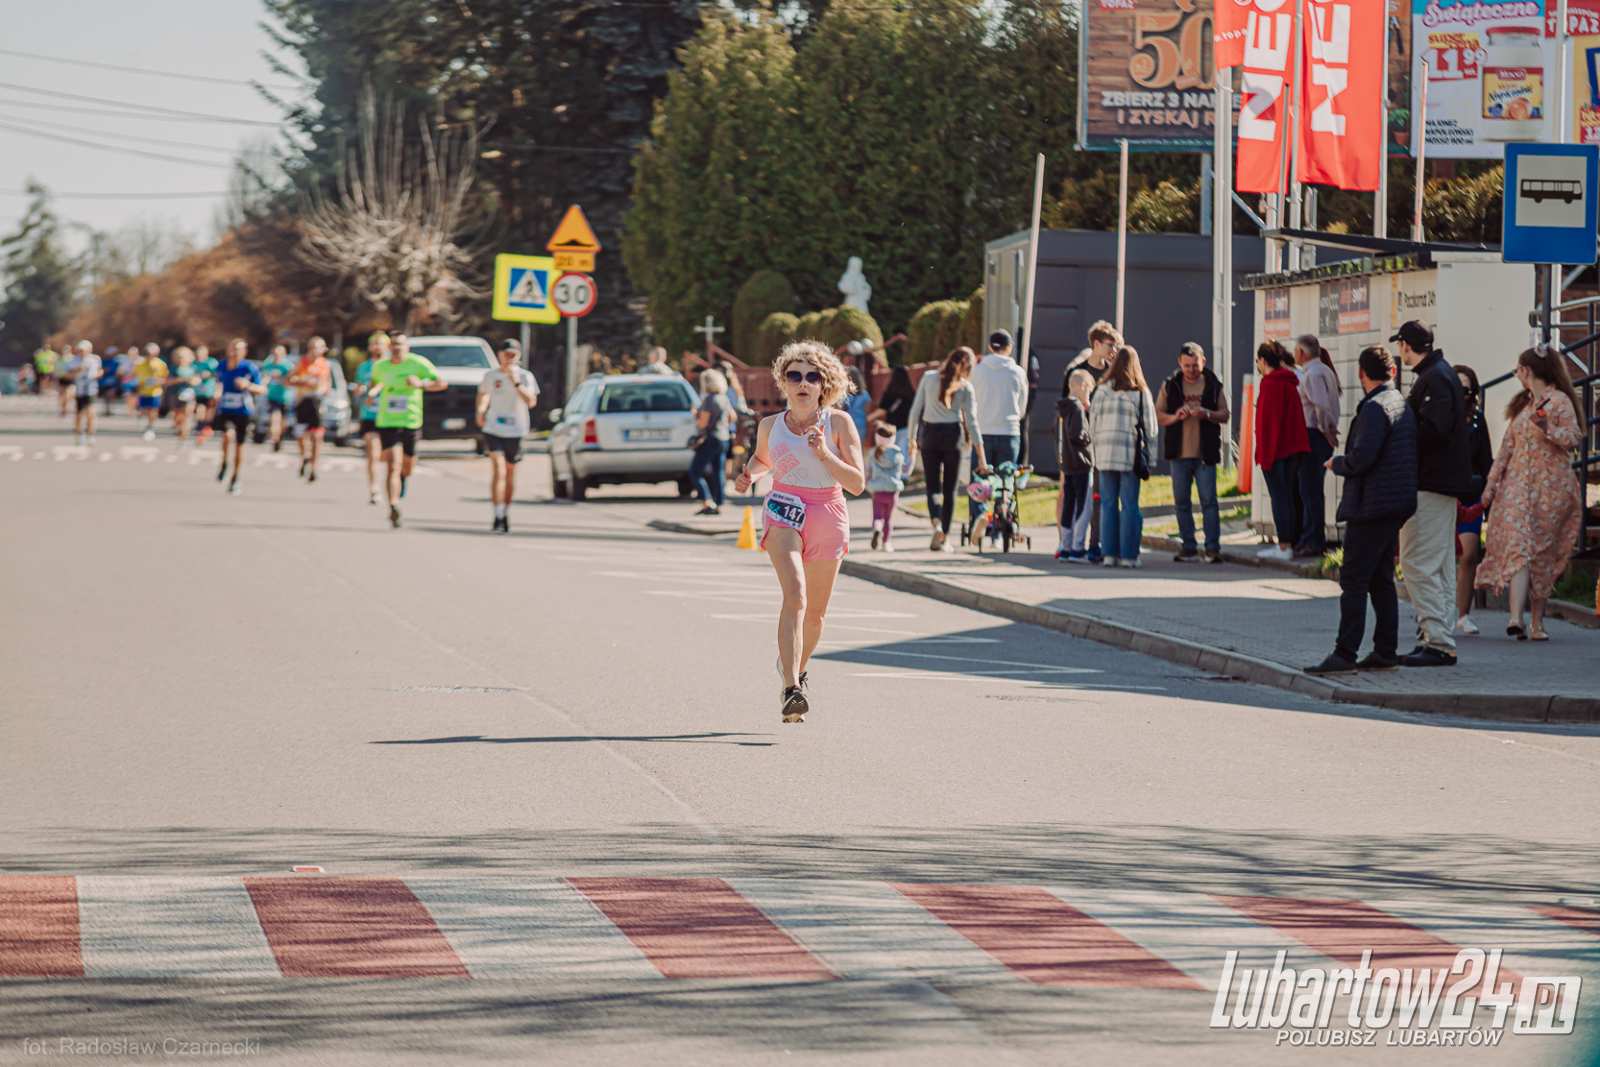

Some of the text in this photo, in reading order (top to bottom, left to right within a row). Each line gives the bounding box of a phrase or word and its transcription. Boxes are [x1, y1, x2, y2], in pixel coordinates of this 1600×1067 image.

[1423, 2, 1539, 27] Świąteczne
[1101, 91, 1165, 107] ZBIERZ
[1117, 109, 1125, 125] I
[1129, 109, 1199, 129] ZYSKAJ
[559, 283, 588, 304] 30
[784, 504, 803, 522] 147
